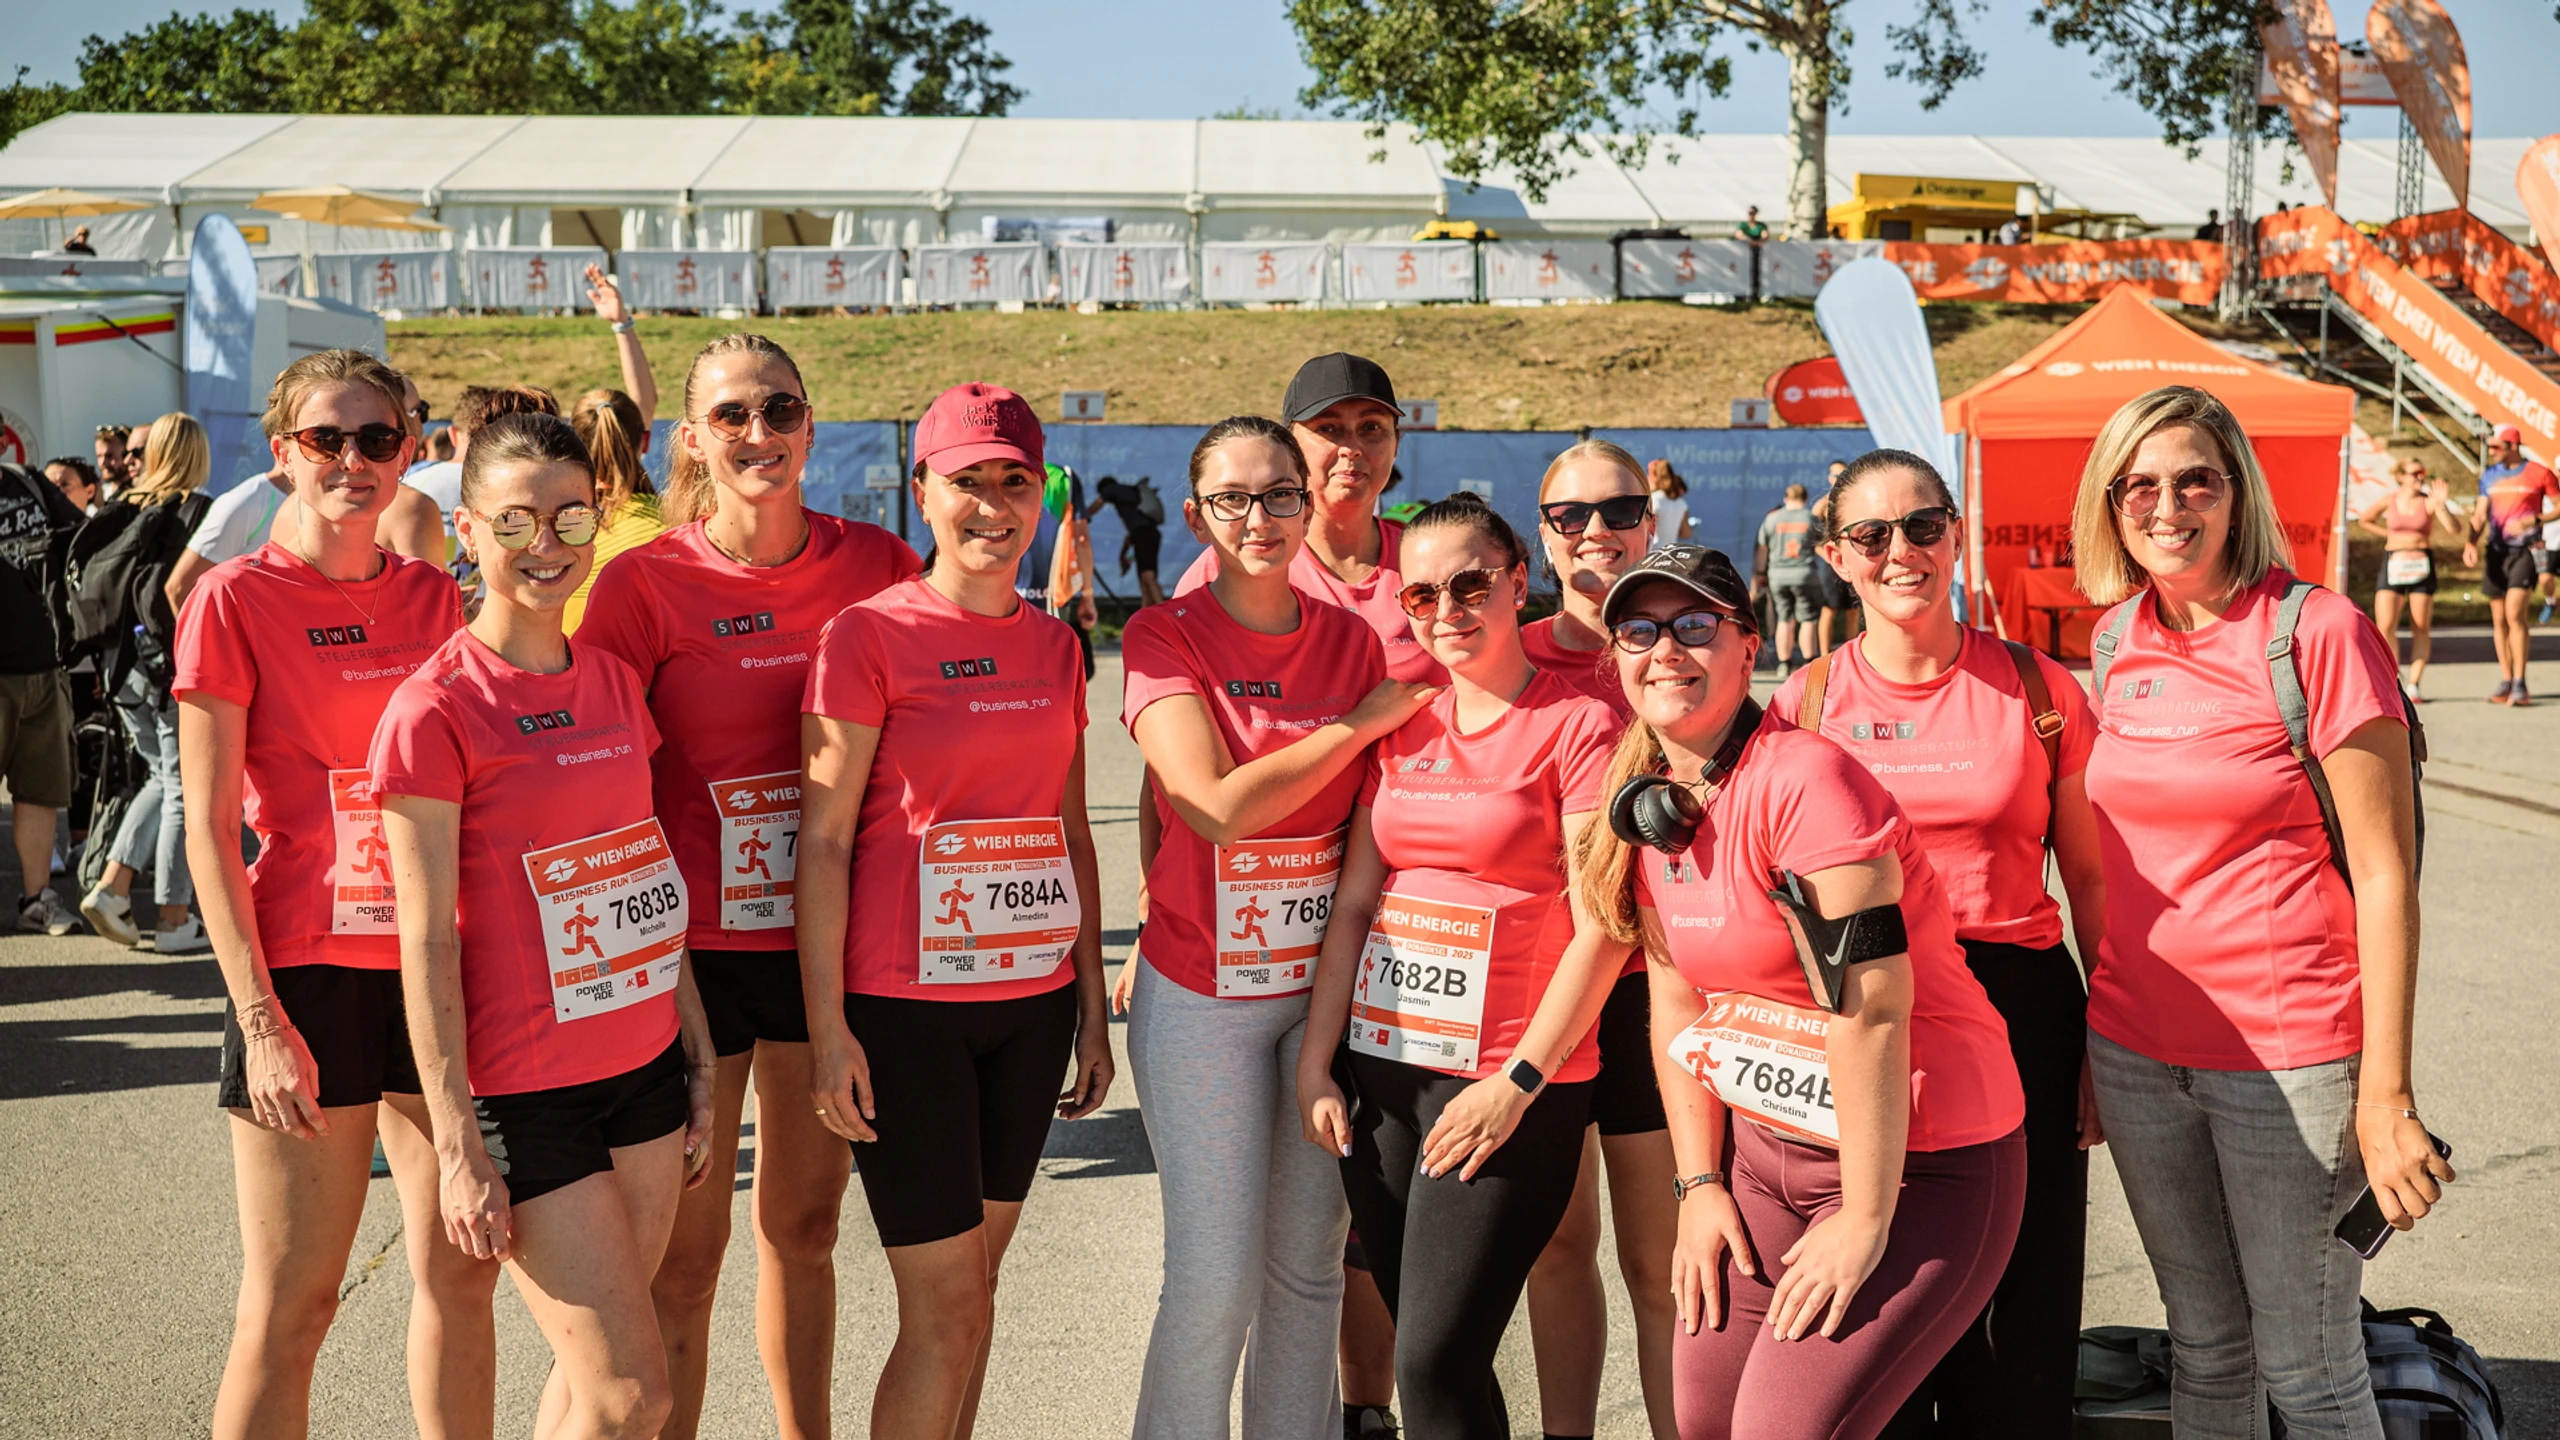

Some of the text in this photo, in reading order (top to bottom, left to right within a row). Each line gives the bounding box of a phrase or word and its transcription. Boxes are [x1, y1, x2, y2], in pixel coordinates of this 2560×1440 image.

[2021, 258, 2205, 284] WIEN ENERGIE
[2091, 359, 2250, 377] WIEN ENERGIE
[2431, 323, 2480, 378] WIEN
[2475, 361, 2558, 440] ENERGIE
[1666, 444, 1829, 464] Wiener Wasser
[1709, 471, 1784, 489] suchen
[715, 613, 772, 636] SWT
[309, 626, 366, 645] SWT
[719, 629, 821, 652] STEUERBERAT
[316, 639, 435, 663] STEUERBERATUNG
[741, 651, 811, 670] @business
[943, 658, 995, 678] SWT
[342, 660, 427, 682] @business_ru
[945, 678, 1054, 696] STEUERBERATUNG
[1228, 681, 1280, 697] SWT
[2124, 680, 2164, 698] SWT
[969, 697, 1052, 713] @business_run
[519, 710, 573, 733] SWT
[527, 721, 631, 750] STEUERBERATUNG
[1855, 724, 1912, 738] SWT
[2118, 723, 2199, 737] @business_run
[556, 743, 633, 767] @business_run
[1402, 759, 1451, 773] SWT
[1870, 758, 1974, 774] @business_run
[1388, 773, 1500, 786] STEUERBERATUNG
[1390, 788, 1477, 802] @business_run
[349, 811, 382, 822] BUSIN
[734, 812, 800, 827] BUSINESS RU
[973, 834, 1058, 850] WIEN ENERGIE
[583, 835, 661, 870] WIEN ENERGIE
[1267, 853, 1312, 868] WIEN
[933, 864, 988, 875] BUSINESS
[991, 863, 1011, 873] RUN
[552, 882, 608, 905] BUSINESS
[610, 876, 629, 890] RUN
[1229, 882, 1283, 892] BUSINESS
[1287, 879, 1309, 890] RUN
[986, 878, 1068, 911] 7684A
[356, 906, 395, 915] POWER
[609, 882, 680, 930] 7683B
[741, 902, 774, 912] POWER
[756, 910, 774, 918] ADE
[1281, 890, 1336, 925] 768
[373, 914, 394, 923] ADE
[1011, 911, 1049, 923] Almedina
[1384, 908, 1480, 938] WIEN ENERGIE
[1671, 914, 1725, 929] @business_run
[639, 920, 667, 937] Michelle
[940, 955, 975, 964] POWER
[1452, 949, 1474, 960] 2025
[956, 963, 975, 972] ADE
[1236, 968, 1270, 977] POWER
[1252, 976, 1270, 985] ADE
[1378, 956, 1467, 997] 7682B
[576, 981, 613, 997] POWER
[594, 989, 615, 1002] ADE
[1397, 993, 1431, 1007] Jasmin
[1735, 1003, 1783, 1027] WIEN
[1745, 1036, 1772, 1051] RUN
[1761, 1098, 1807, 1119] Christina
